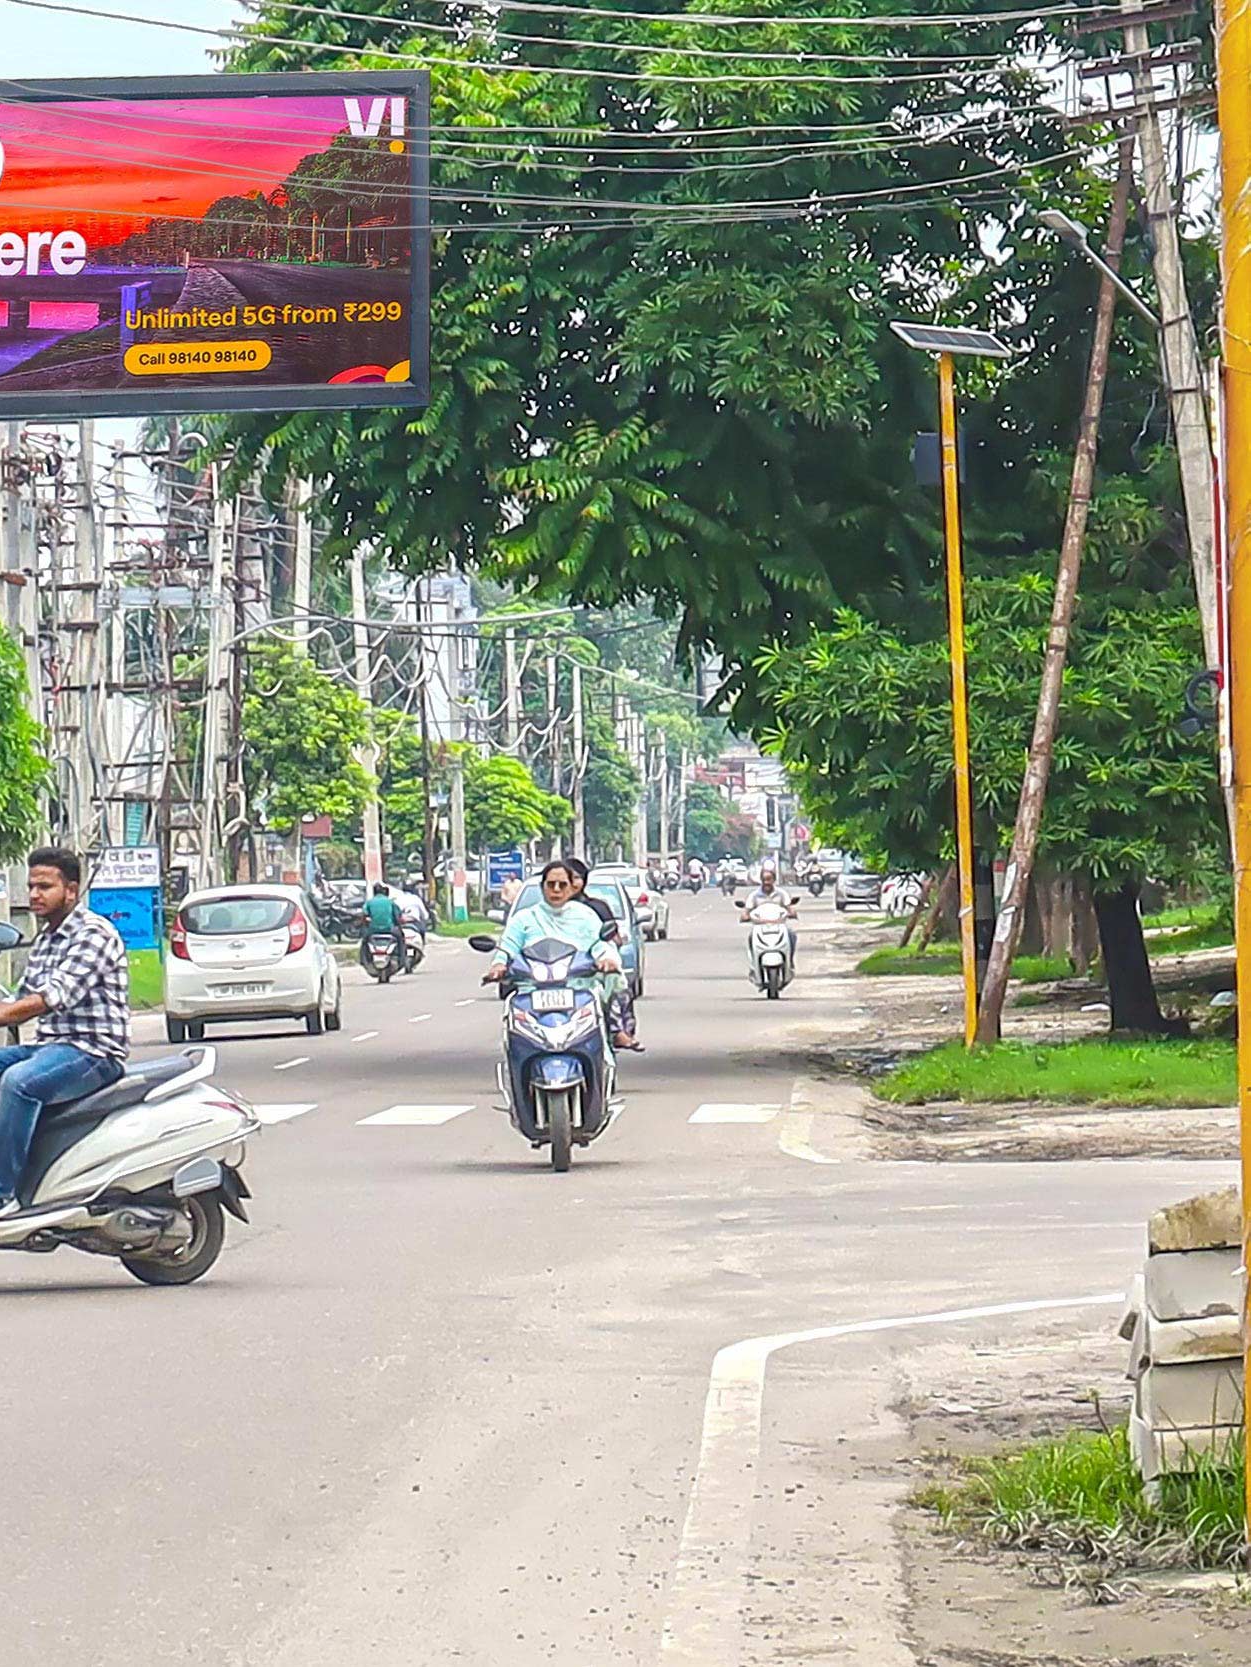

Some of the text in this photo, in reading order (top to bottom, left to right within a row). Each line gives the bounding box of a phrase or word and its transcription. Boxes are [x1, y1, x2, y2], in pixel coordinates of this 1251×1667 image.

[125, 301, 402, 330] Unlimited 5G from ₹299
[139, 349, 257, 366] Call 98140 98140
